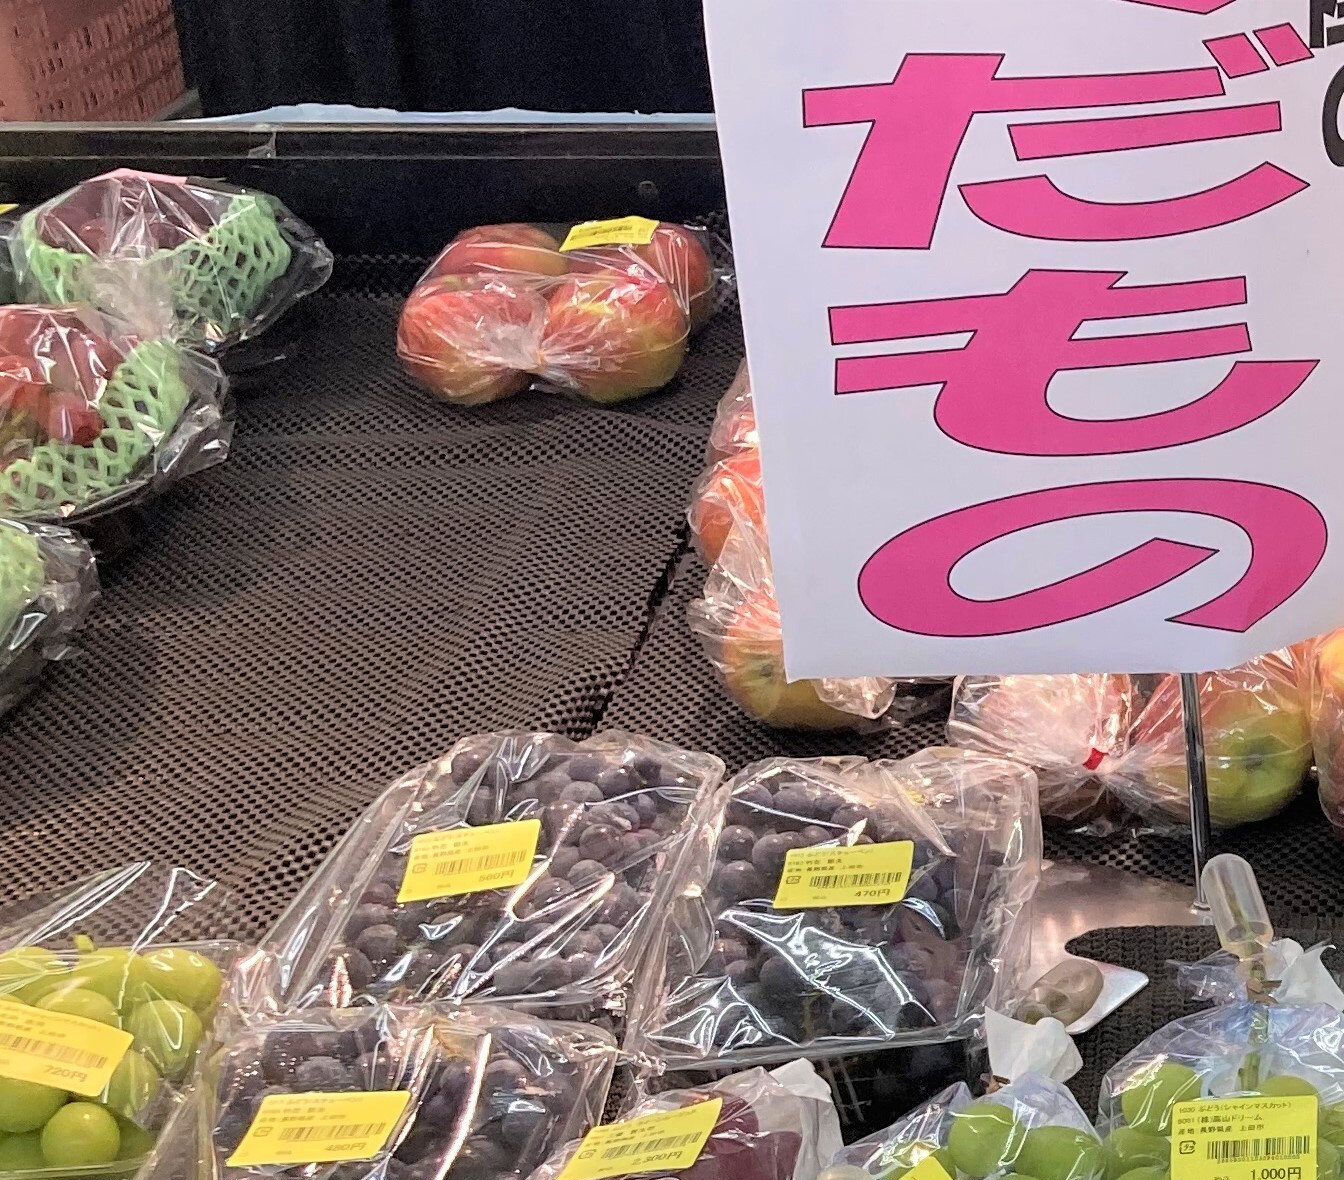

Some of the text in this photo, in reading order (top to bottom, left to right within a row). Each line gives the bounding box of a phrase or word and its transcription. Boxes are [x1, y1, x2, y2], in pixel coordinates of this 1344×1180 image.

[803, 0, 1328, 638] だもの
[44, 1065, 88, 1083] 720円
